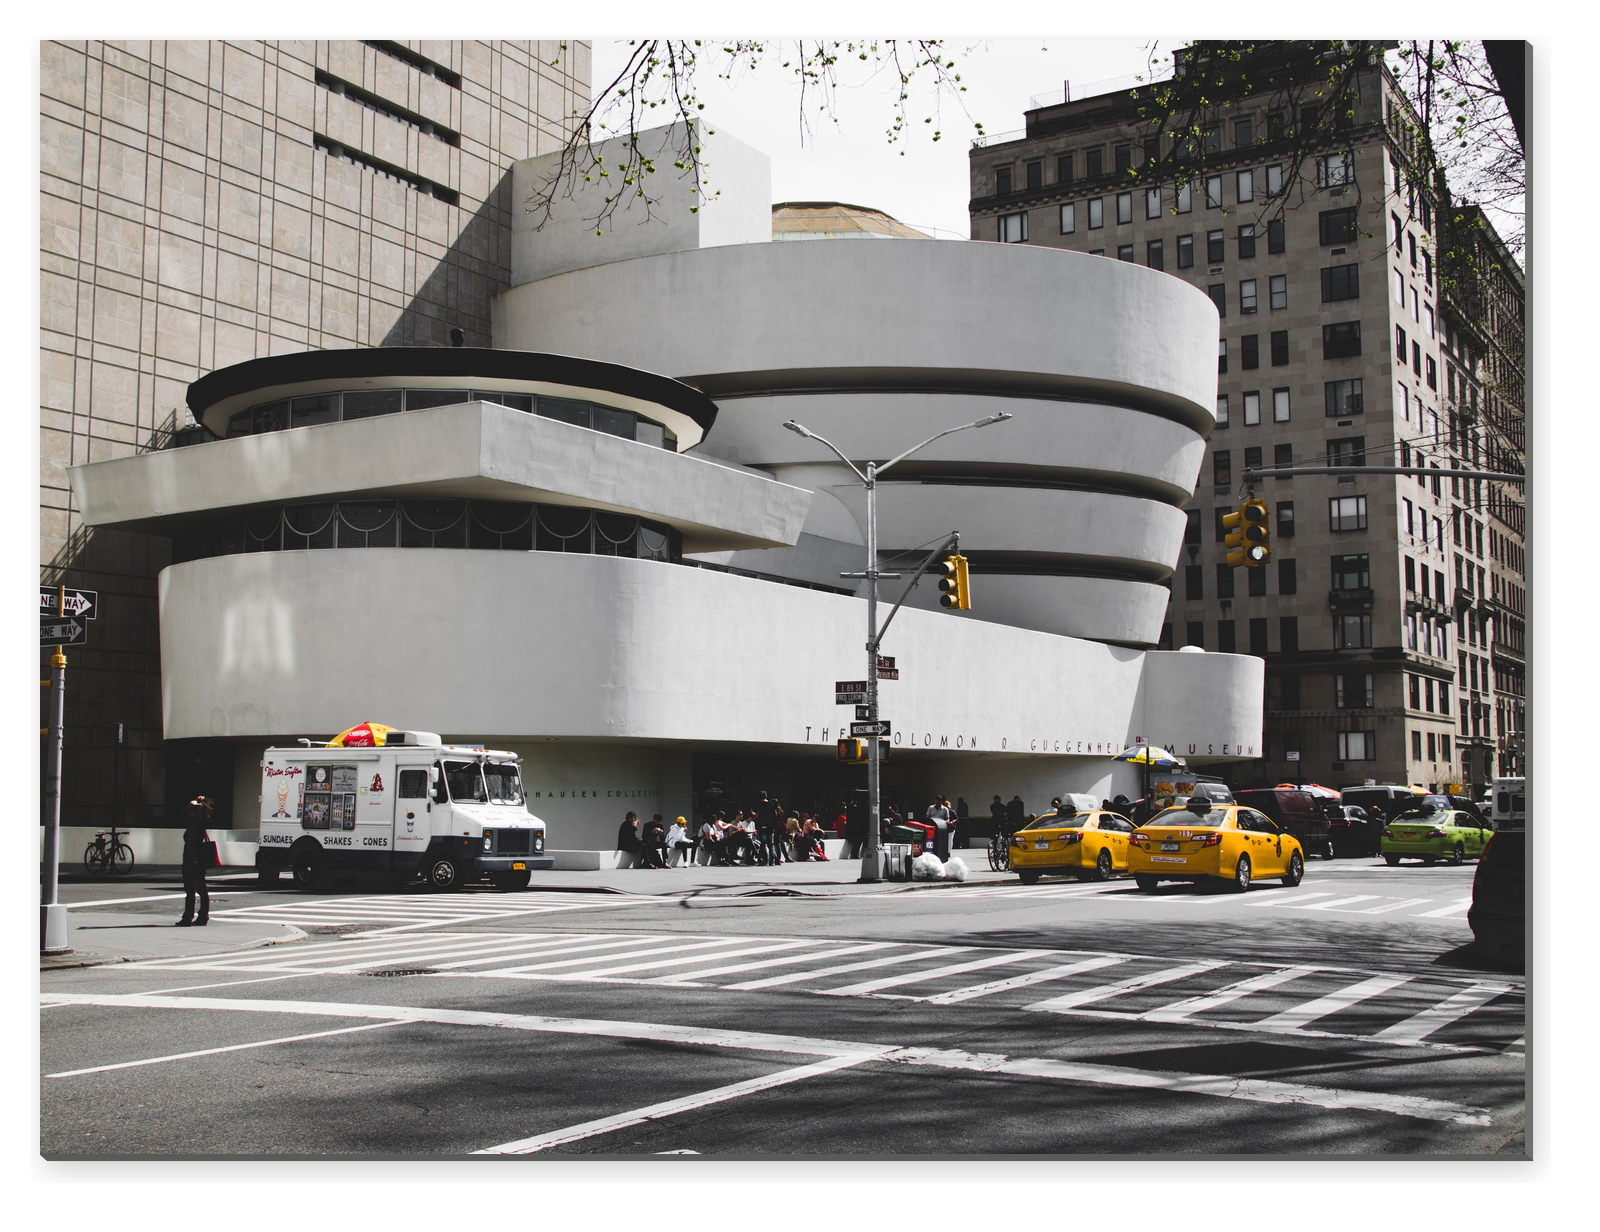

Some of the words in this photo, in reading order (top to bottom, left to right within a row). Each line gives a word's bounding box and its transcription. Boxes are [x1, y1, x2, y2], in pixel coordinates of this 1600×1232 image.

[40, 595, 54, 607] NE
[64, 598, 85, 609] WAY
[40, 627, 54, 638] ONE
[61, 625, 78, 636] WAY
[841, 684, 845, 692] E
[847, 684, 854, 692] 89
[855, 684, 862, 692] St
[894, 732, 977, 748] OLOMON
[1163, 744, 1254, 755] MUSEUM
[263, 835, 293, 844] SUNDAES
[324, 836, 352, 846] SHAKES
[363, 837, 388, 847] CONES
